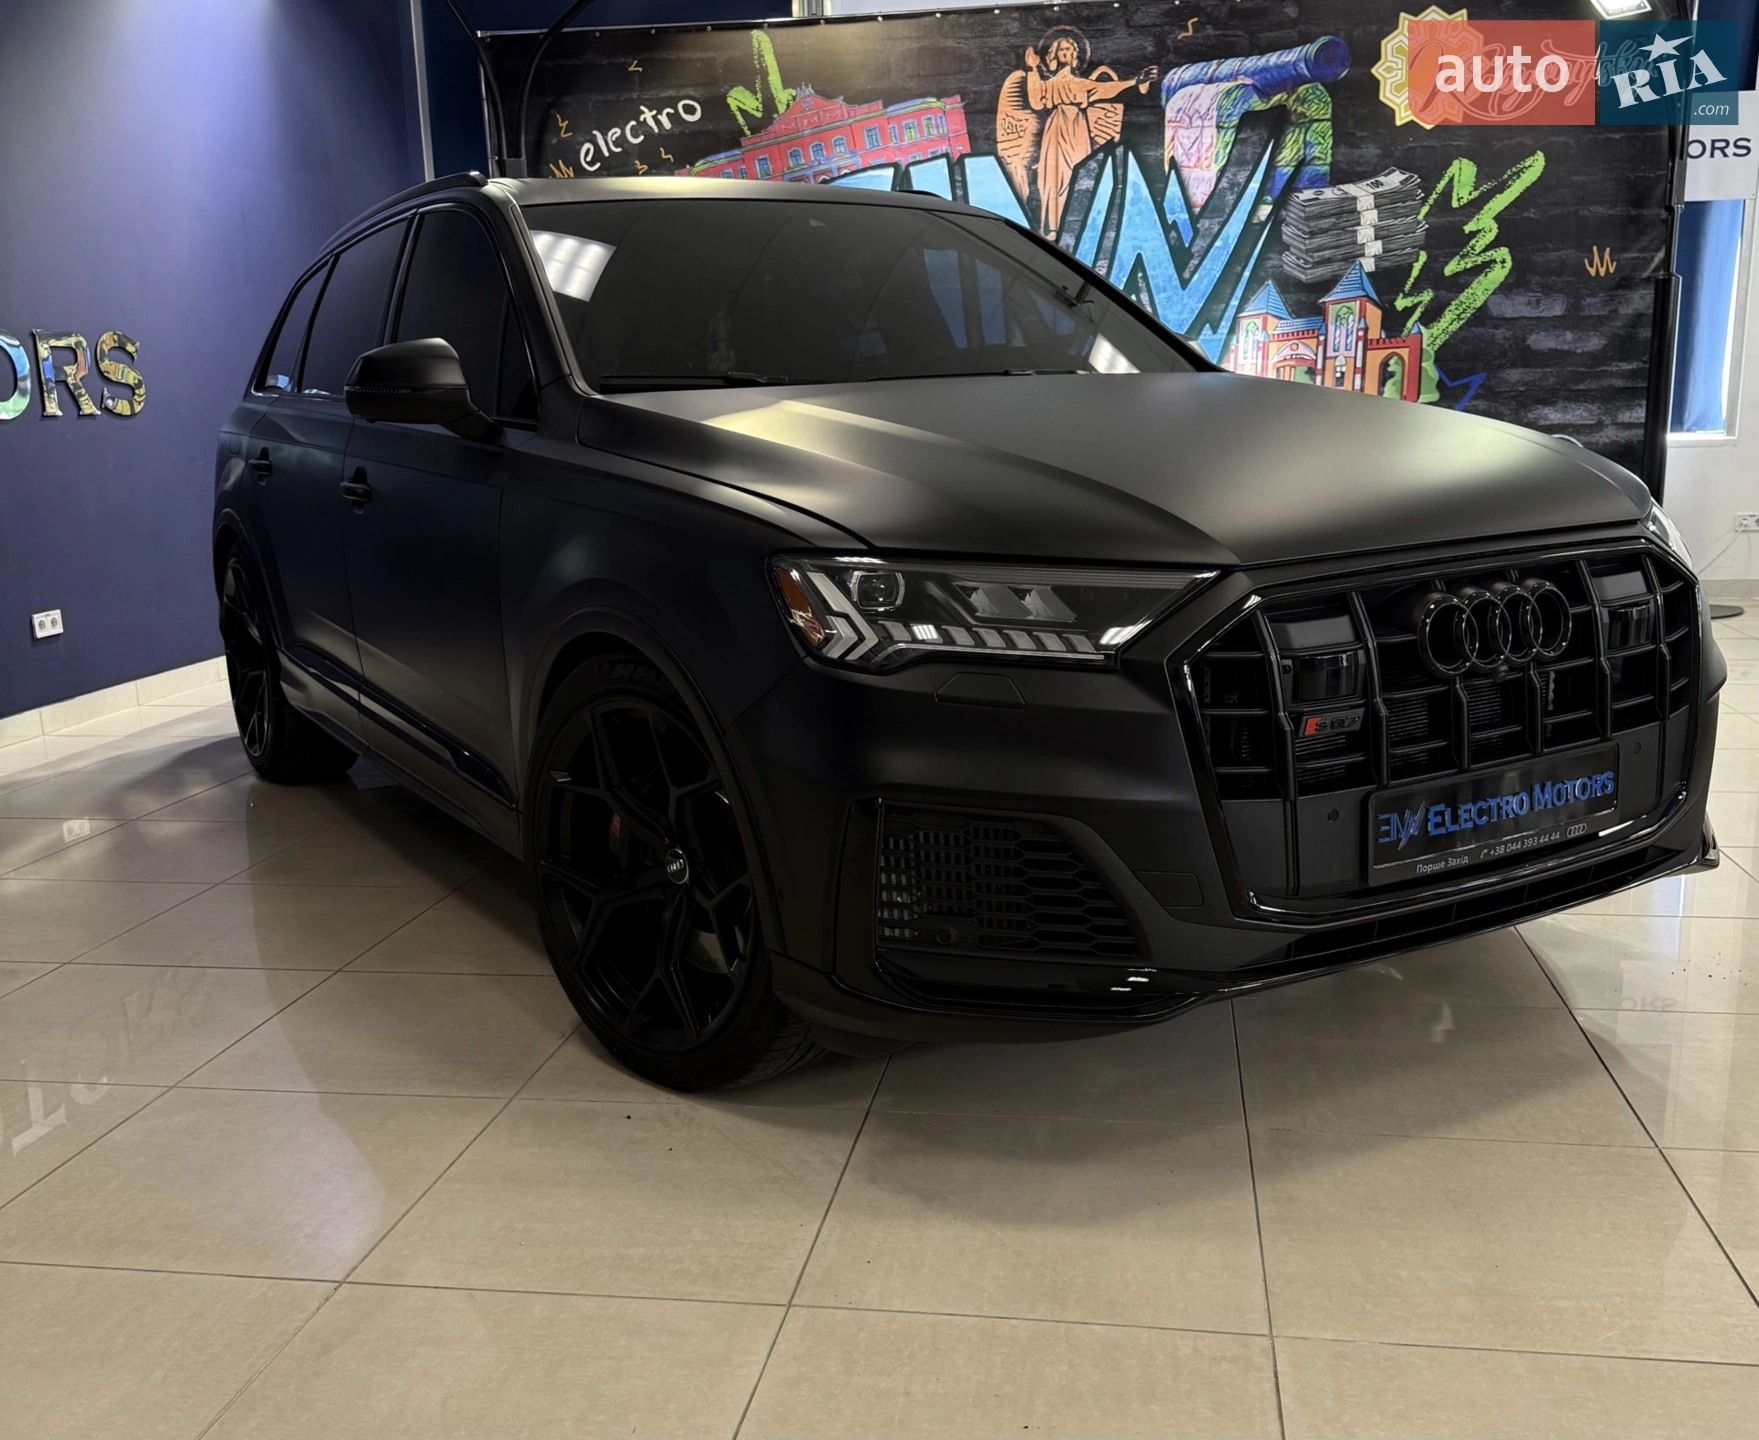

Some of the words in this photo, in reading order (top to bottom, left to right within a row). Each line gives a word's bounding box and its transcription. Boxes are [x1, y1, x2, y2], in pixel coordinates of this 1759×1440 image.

[580, 100, 701, 171] electro
[1428, 791, 1530, 836] ELECTRO
[1533, 771, 1615, 811] MOTORS
[1416, 861, 1445, 874] Порше
[1447, 855, 1469, 869] Захід
[1489, 845, 1505, 856] +38
[1506, 841, 1521, 852] 044
[1523, 837, 1538, 848] 393
[1539, 834, 1549, 844] 44
[1549, 831, 1560, 842] 44
